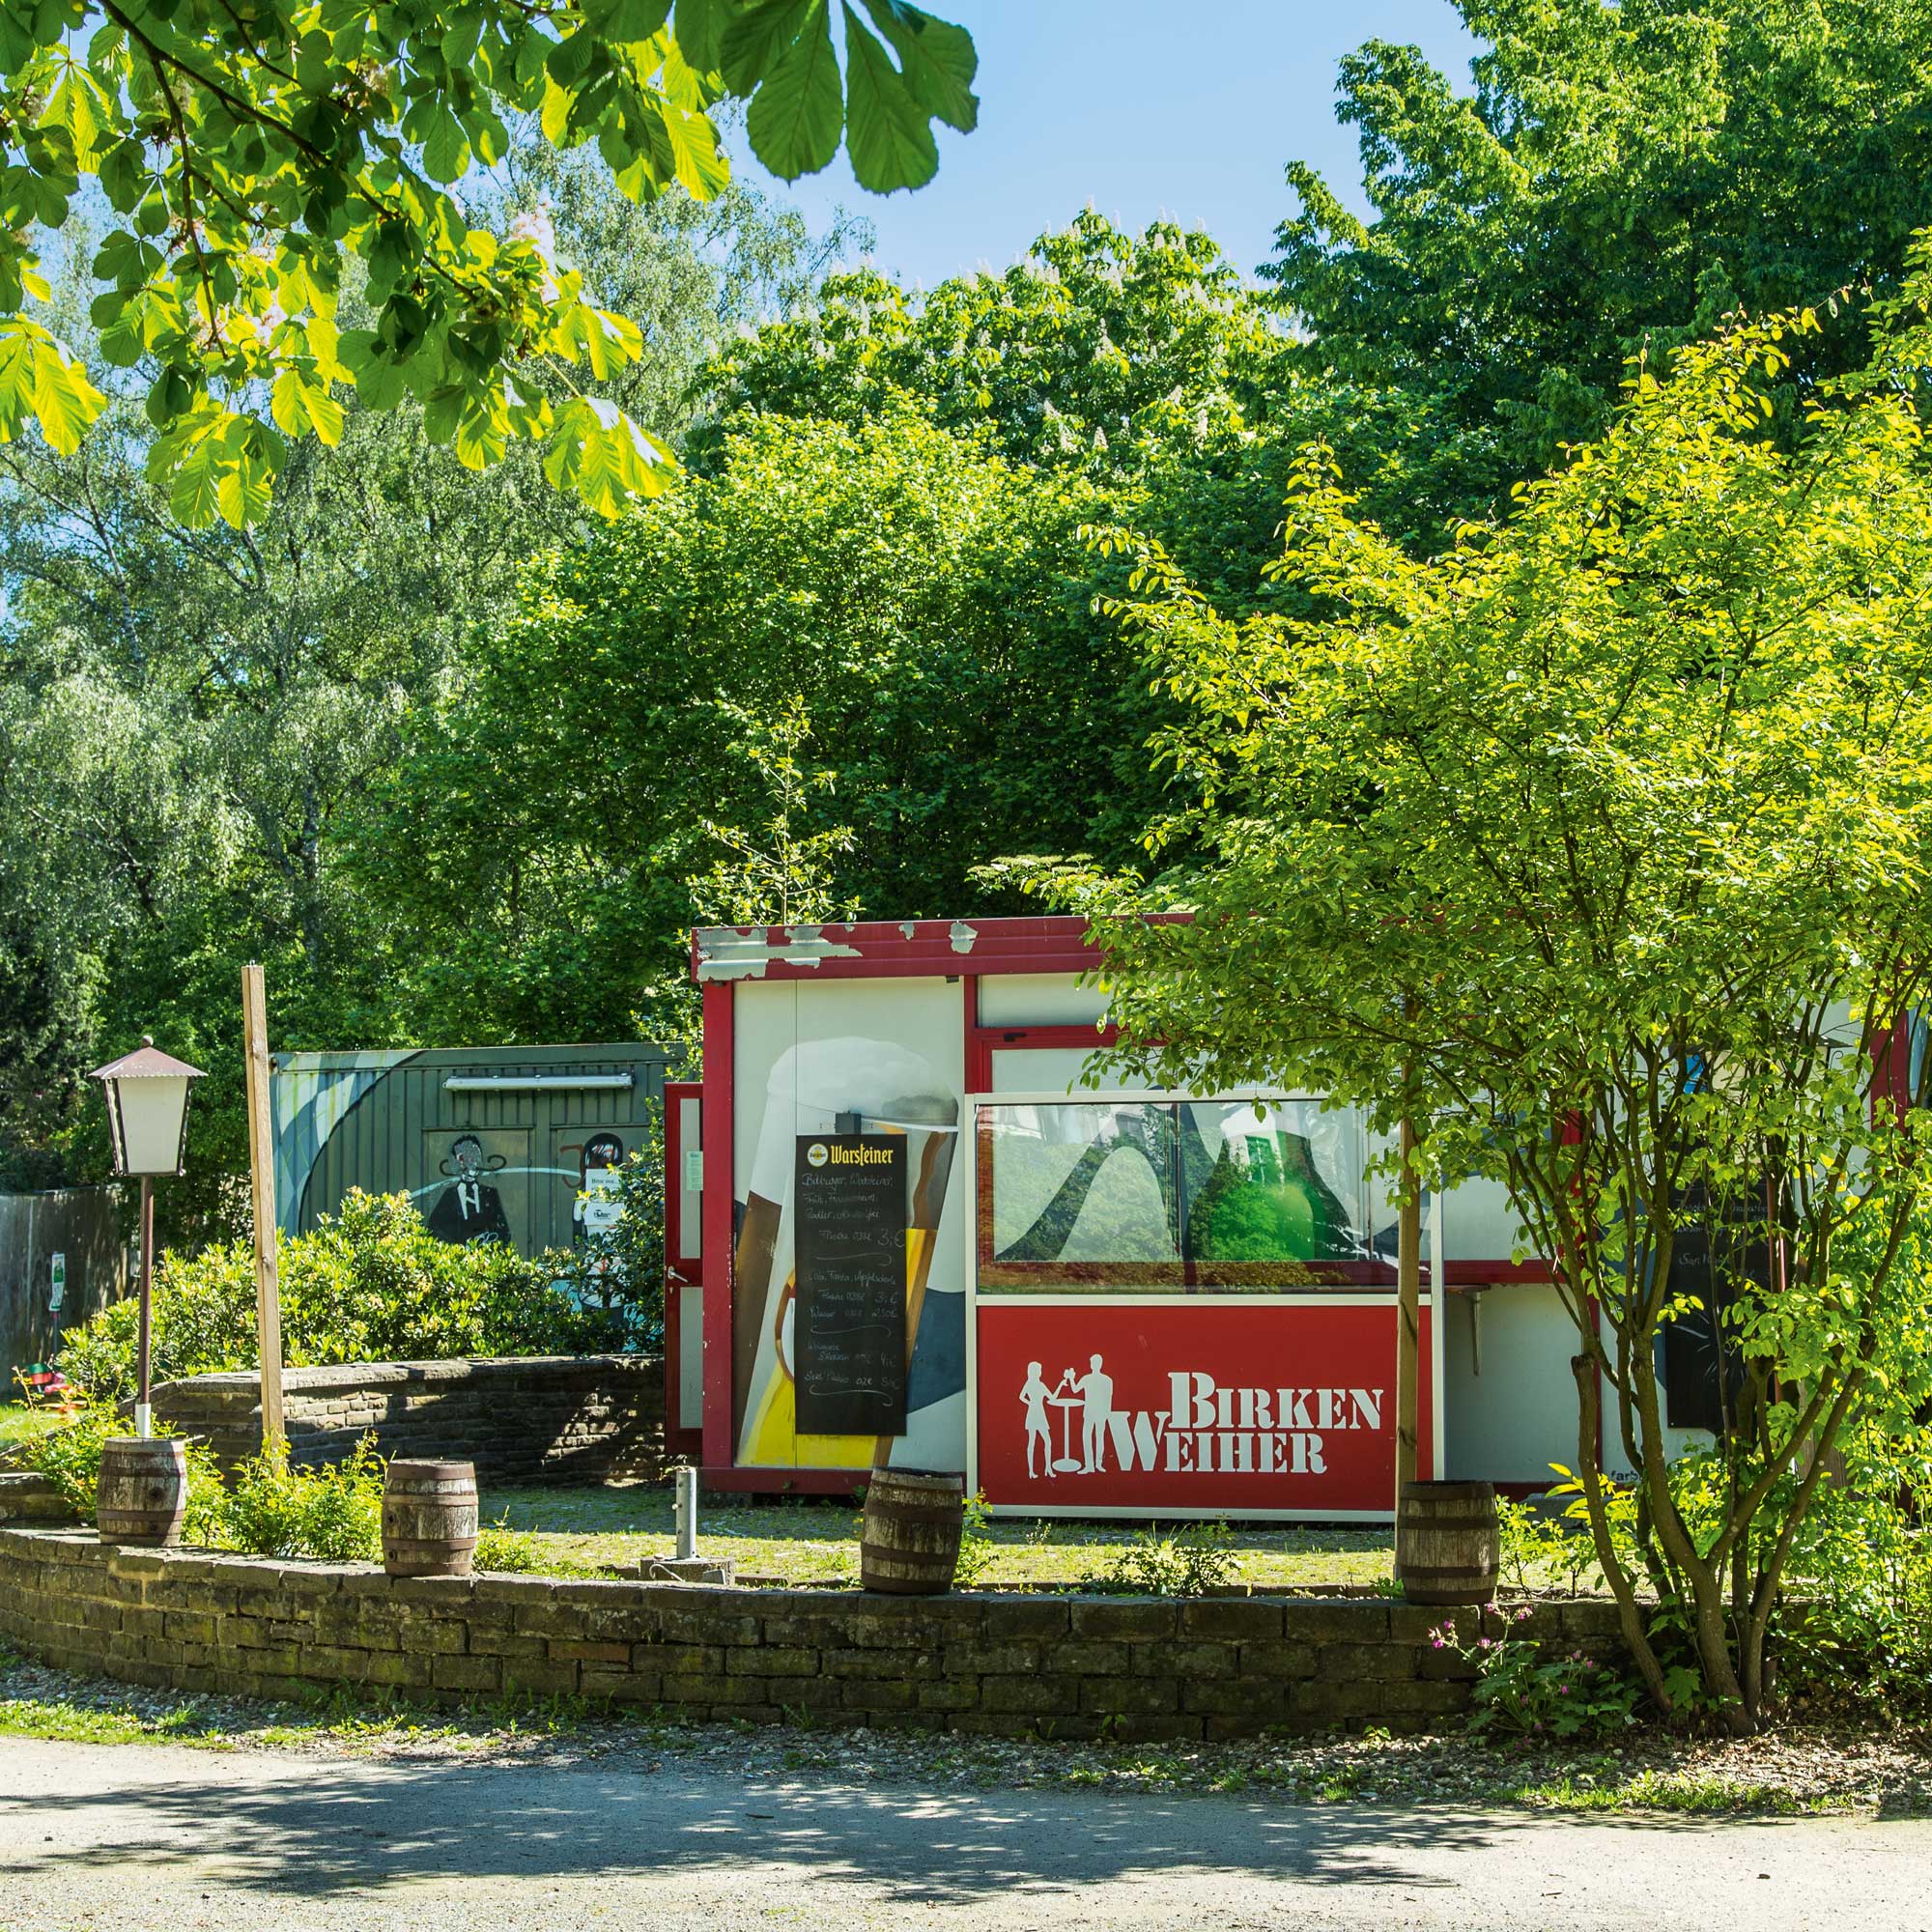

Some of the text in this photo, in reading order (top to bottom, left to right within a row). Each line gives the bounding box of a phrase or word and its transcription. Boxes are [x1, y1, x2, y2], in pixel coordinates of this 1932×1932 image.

[831, 1143, 895, 1167] Warsteiner
[1168, 1372, 1384, 1430] BIRKEN
[1109, 1410, 1327, 1473] WEIHER
[1610, 1469, 1639, 1482] farb
